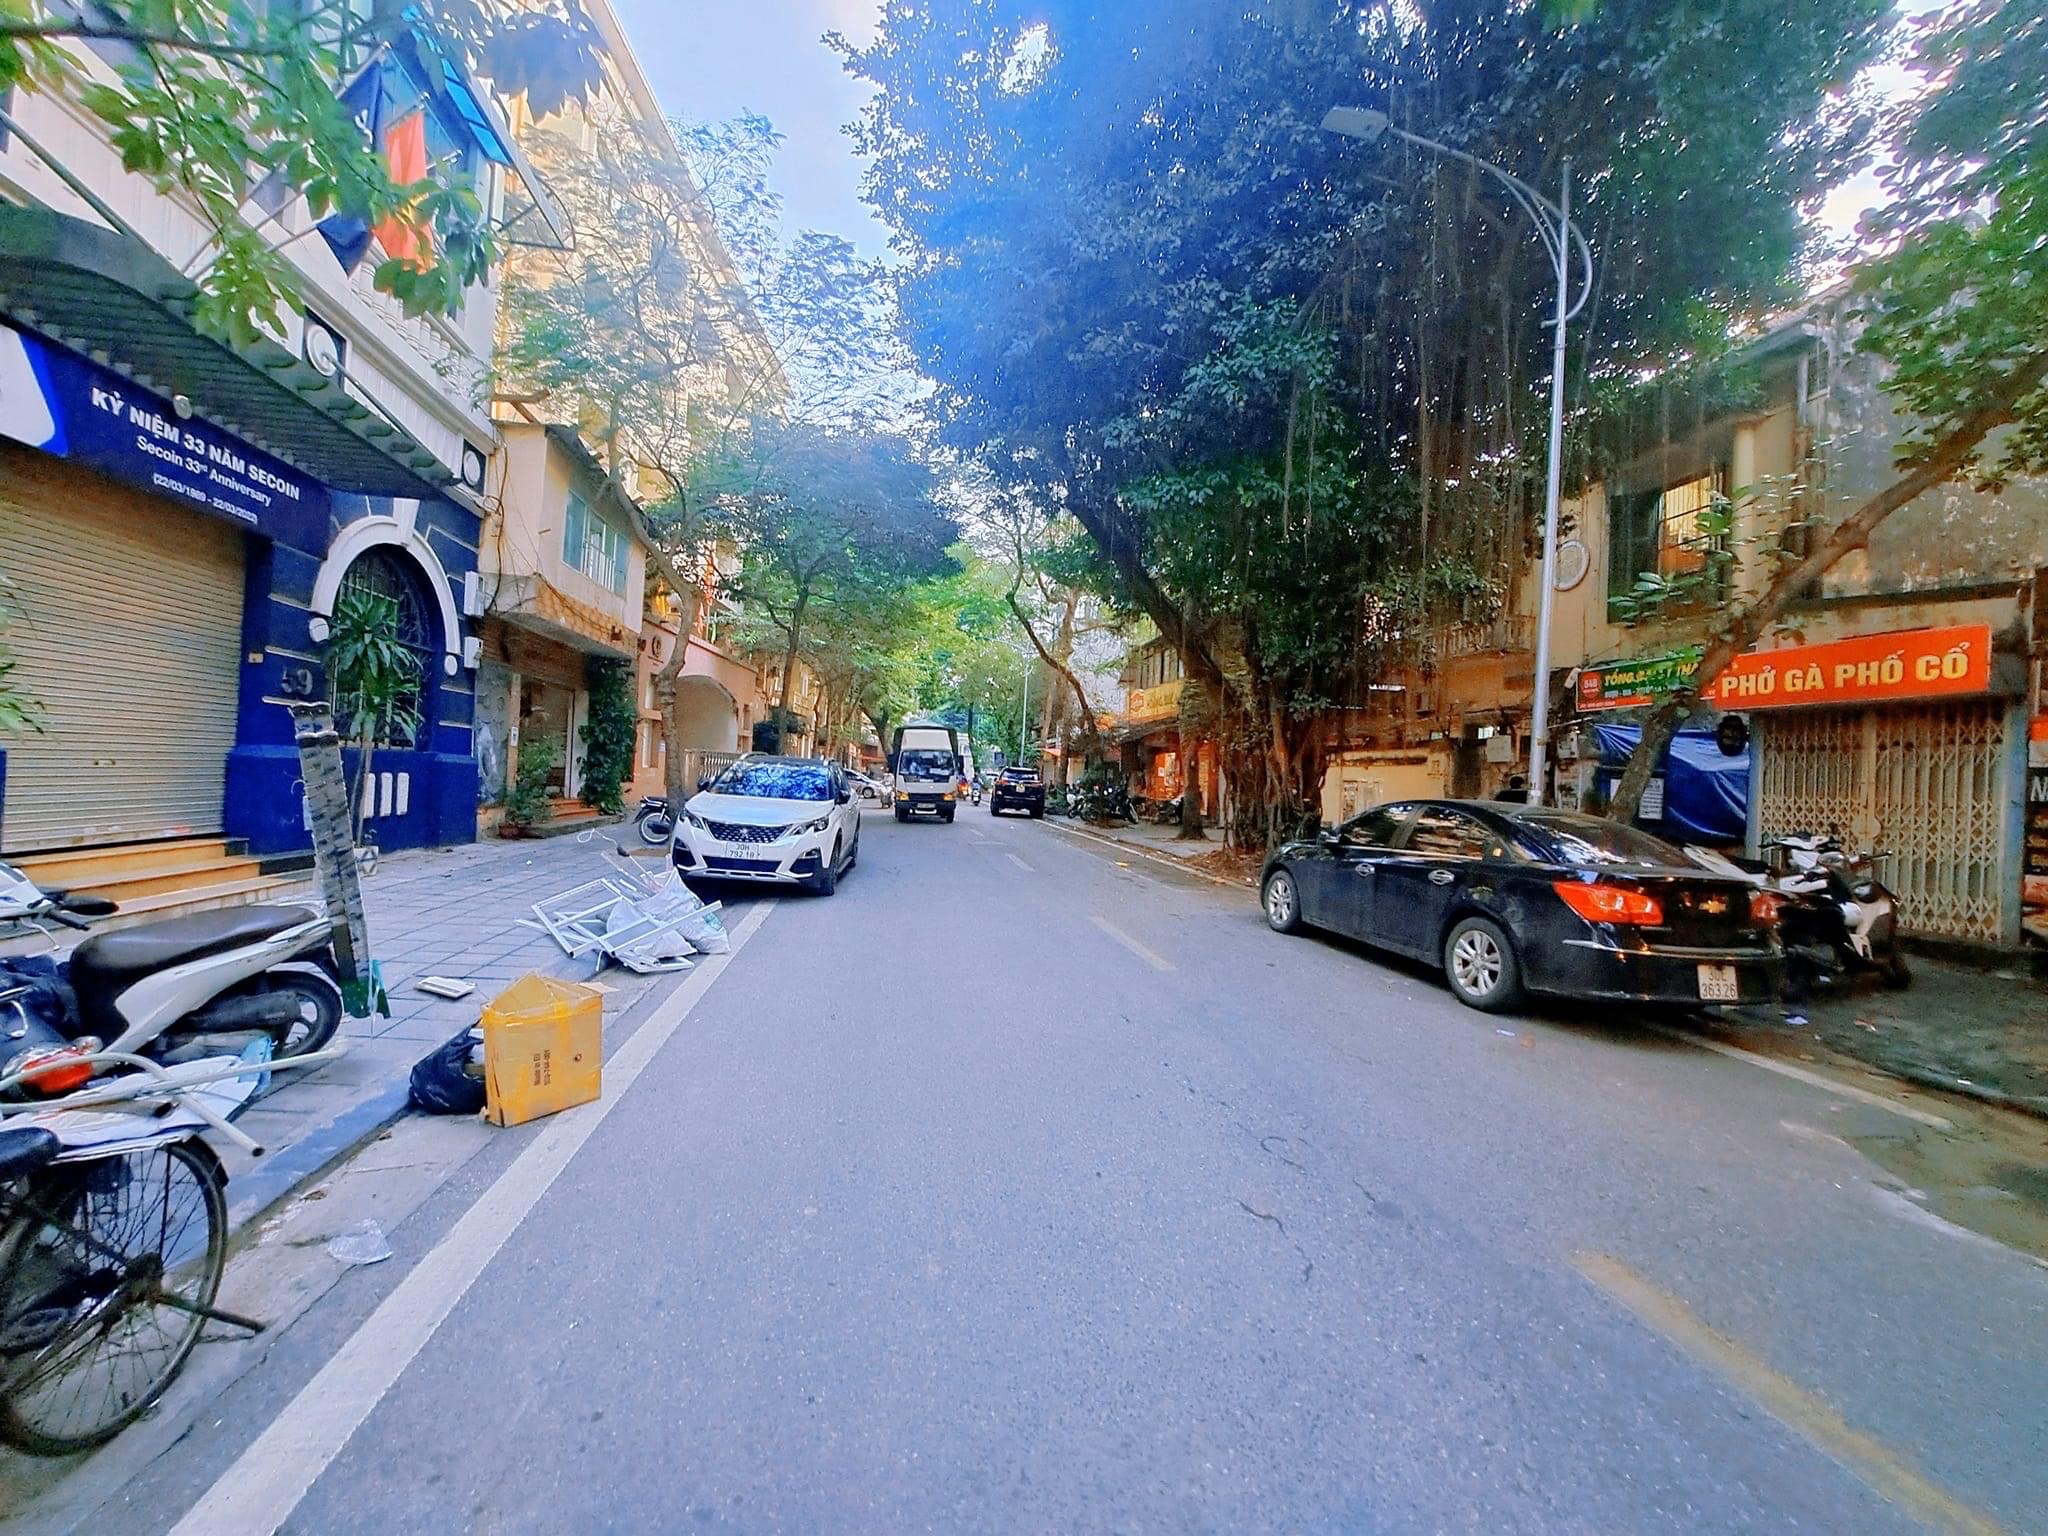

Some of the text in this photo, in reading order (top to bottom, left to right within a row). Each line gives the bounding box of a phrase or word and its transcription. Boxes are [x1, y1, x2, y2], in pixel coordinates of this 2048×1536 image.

[129, 406, 180, 444] NIỆM
[184, 433, 205, 456] 33
[209, 444, 245, 475] NĂM
[248, 463, 300, 501] SECOIN
[136, 435, 183, 467] Secoin
[209, 468, 272, 508] Anniversary
[1721, 664, 1777, 698] PHỞ
[1784, 663, 1825, 692] GÀ
[1835, 650, 1905, 688] PHỐ
[1915, 641, 1971, 681] CỔ
